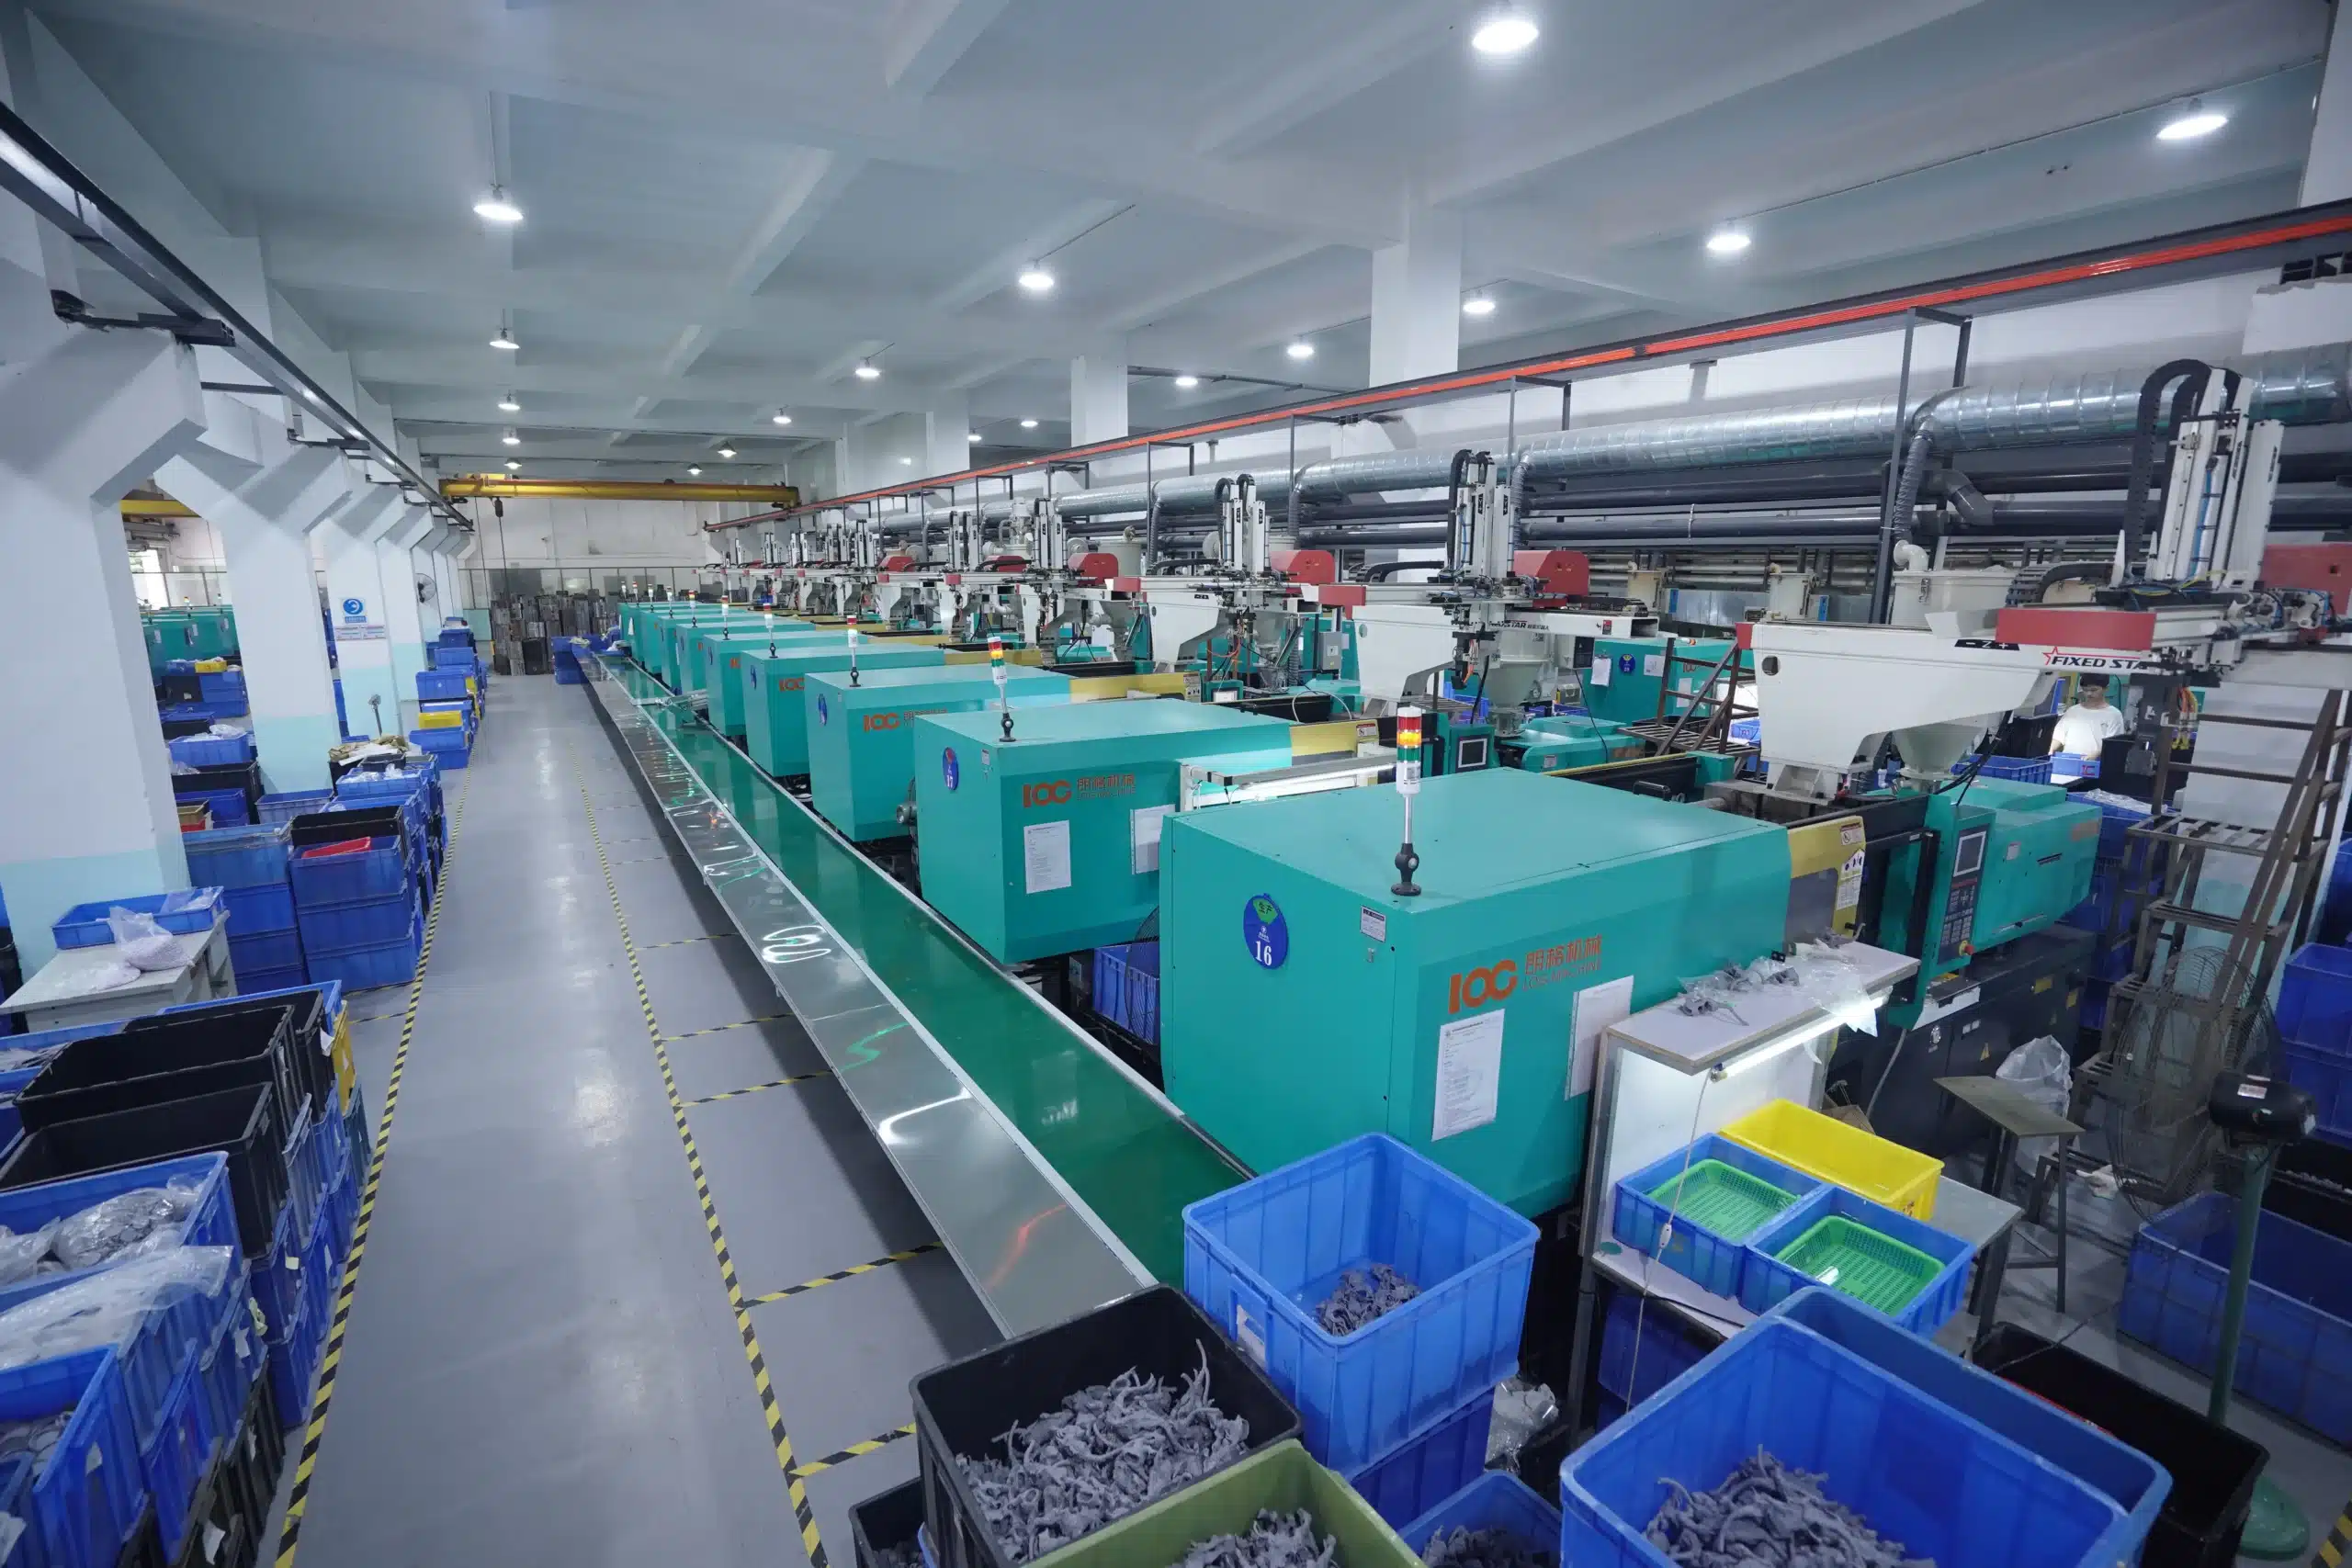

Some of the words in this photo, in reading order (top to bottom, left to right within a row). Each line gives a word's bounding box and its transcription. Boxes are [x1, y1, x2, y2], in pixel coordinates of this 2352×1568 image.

[2052, 656, 2107, 668] FIXED
[2109, 659, 2148, 670] STA
[1255, 940, 1272, 966] 16
